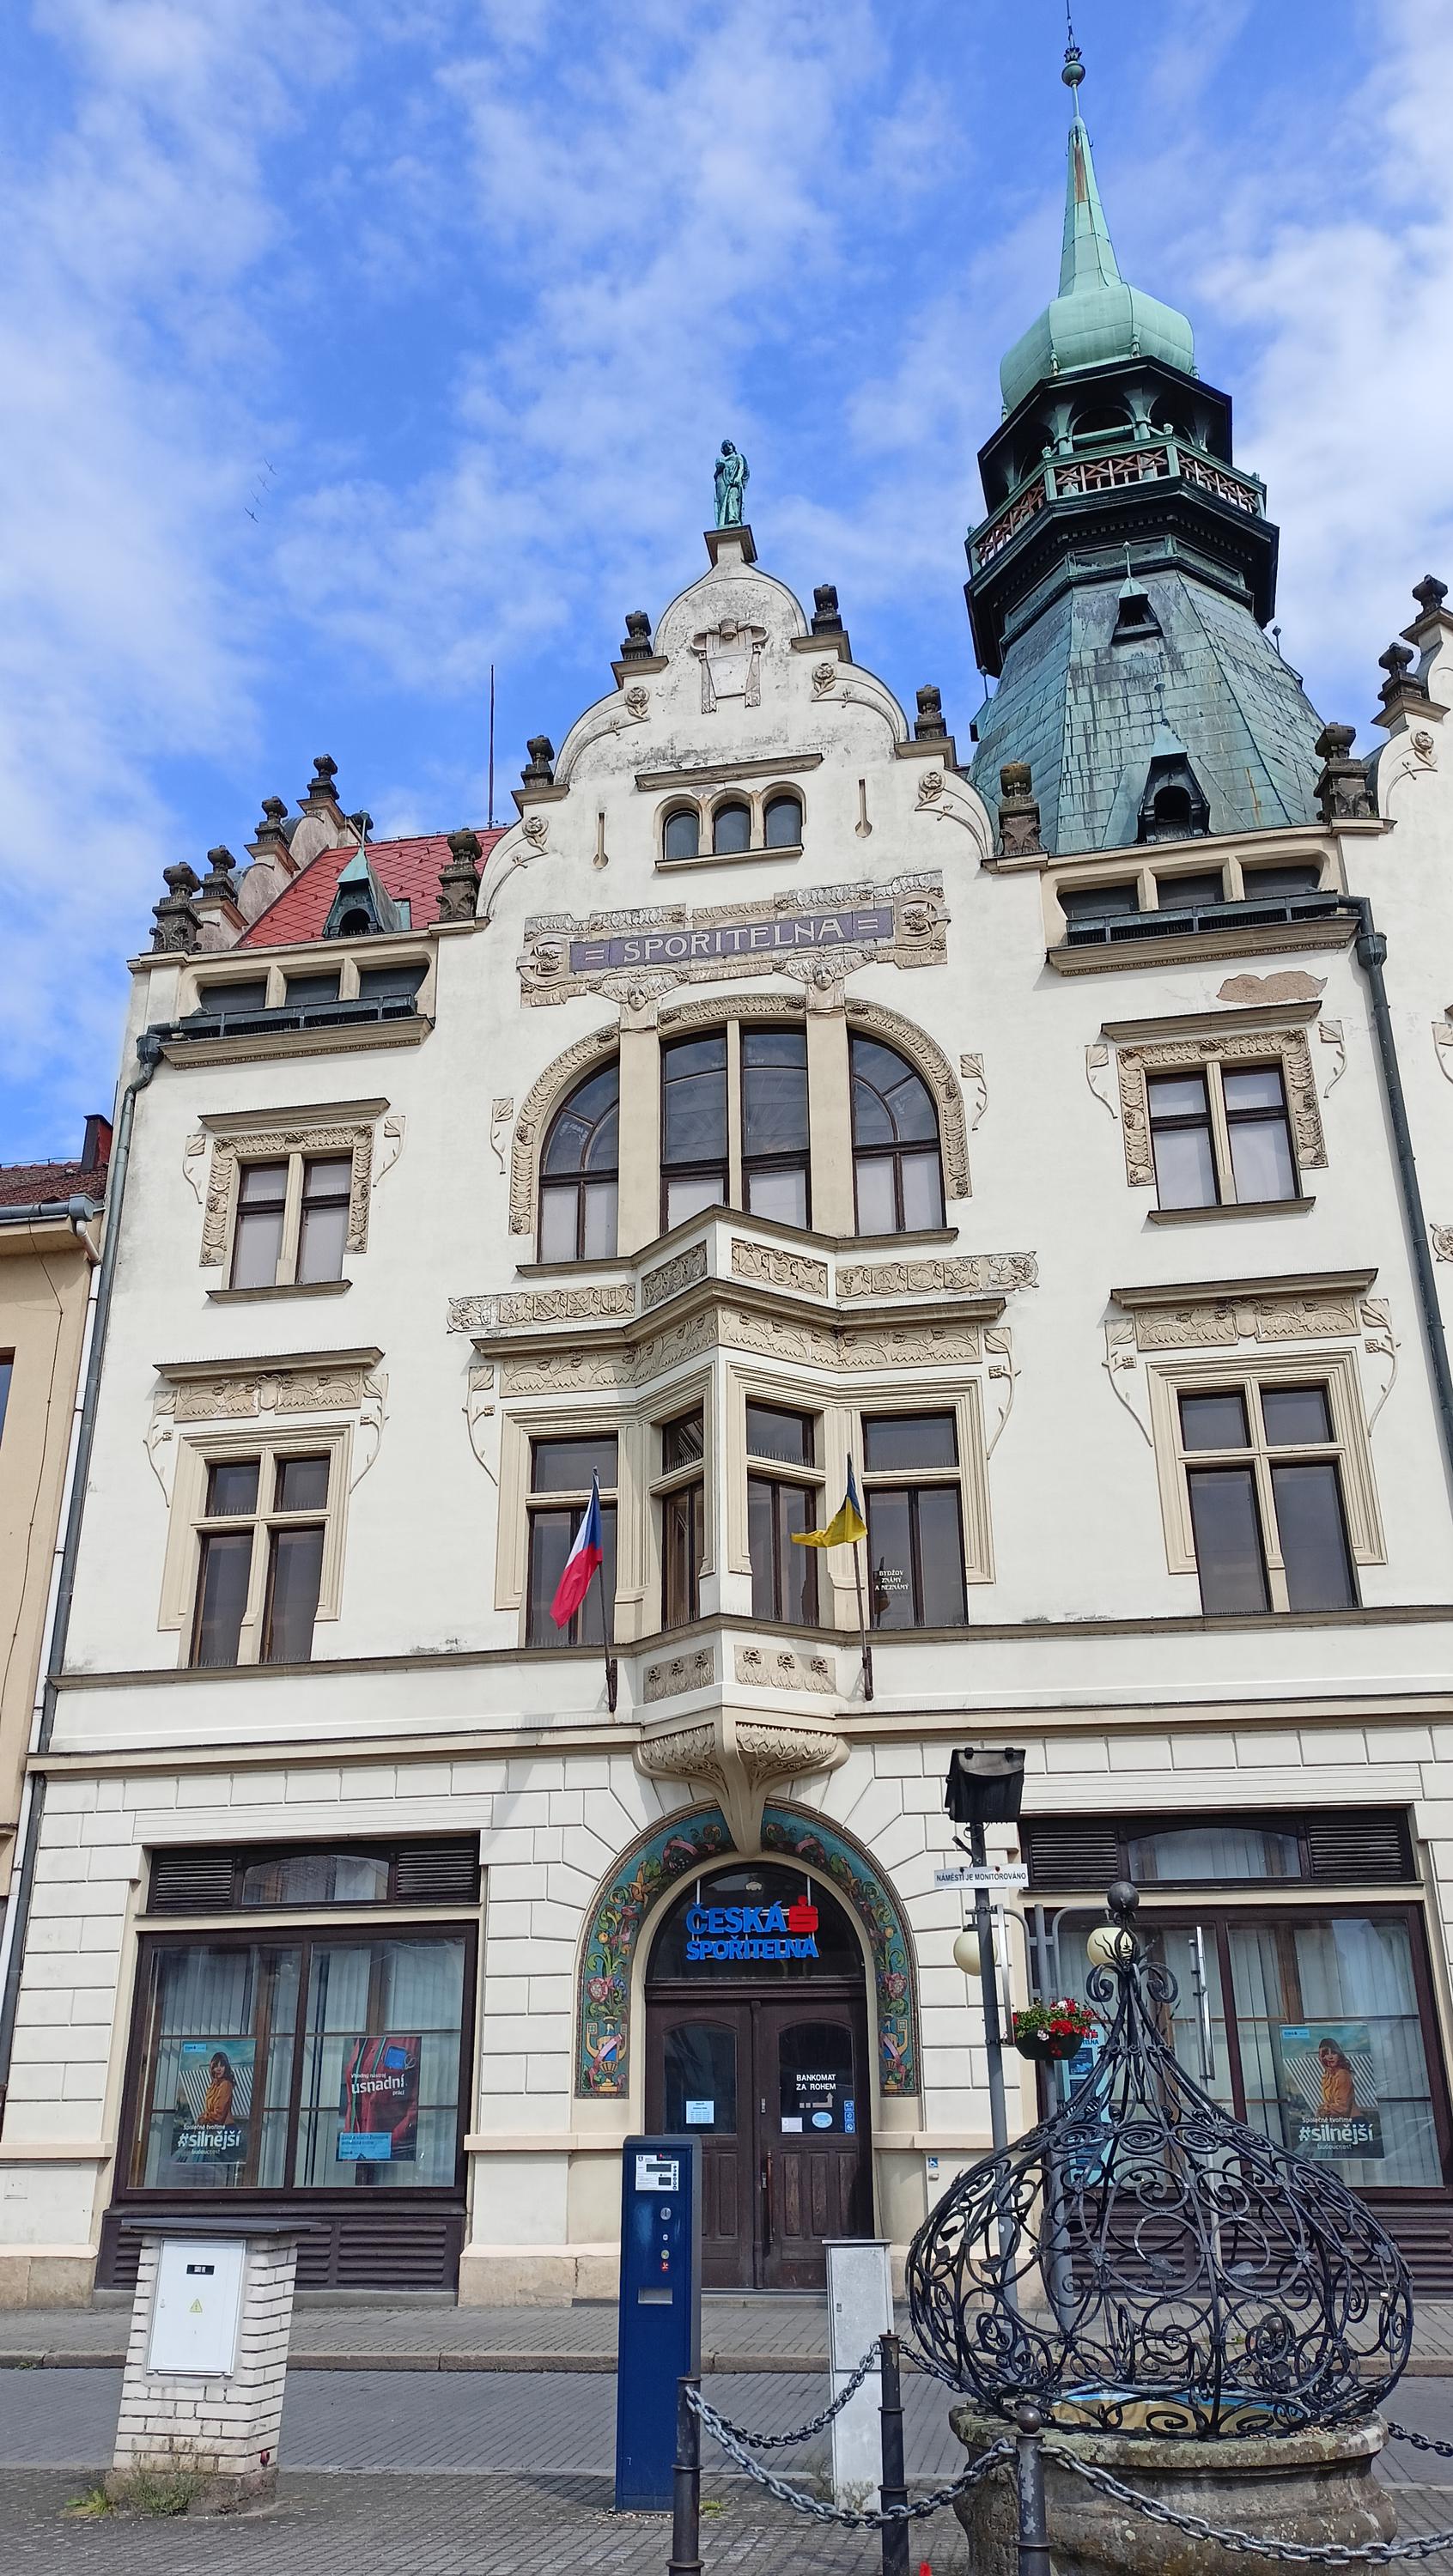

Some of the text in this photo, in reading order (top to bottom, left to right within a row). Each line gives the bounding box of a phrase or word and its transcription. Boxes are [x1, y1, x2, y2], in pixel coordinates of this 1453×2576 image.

[623, 917, 846, 963] SPOŘITELNA
[975, 1872, 1027, 1880] MONITOROVÁNO
[686, 1900, 787, 1934] ČESKÁ
[686, 1935, 820, 1960] SPOŘITELNA
[351, 2074, 404, 2094] usnadní
[177, 2130, 241, 2150] #silnější
[1298, 2123, 1374, 2145] #silnější
